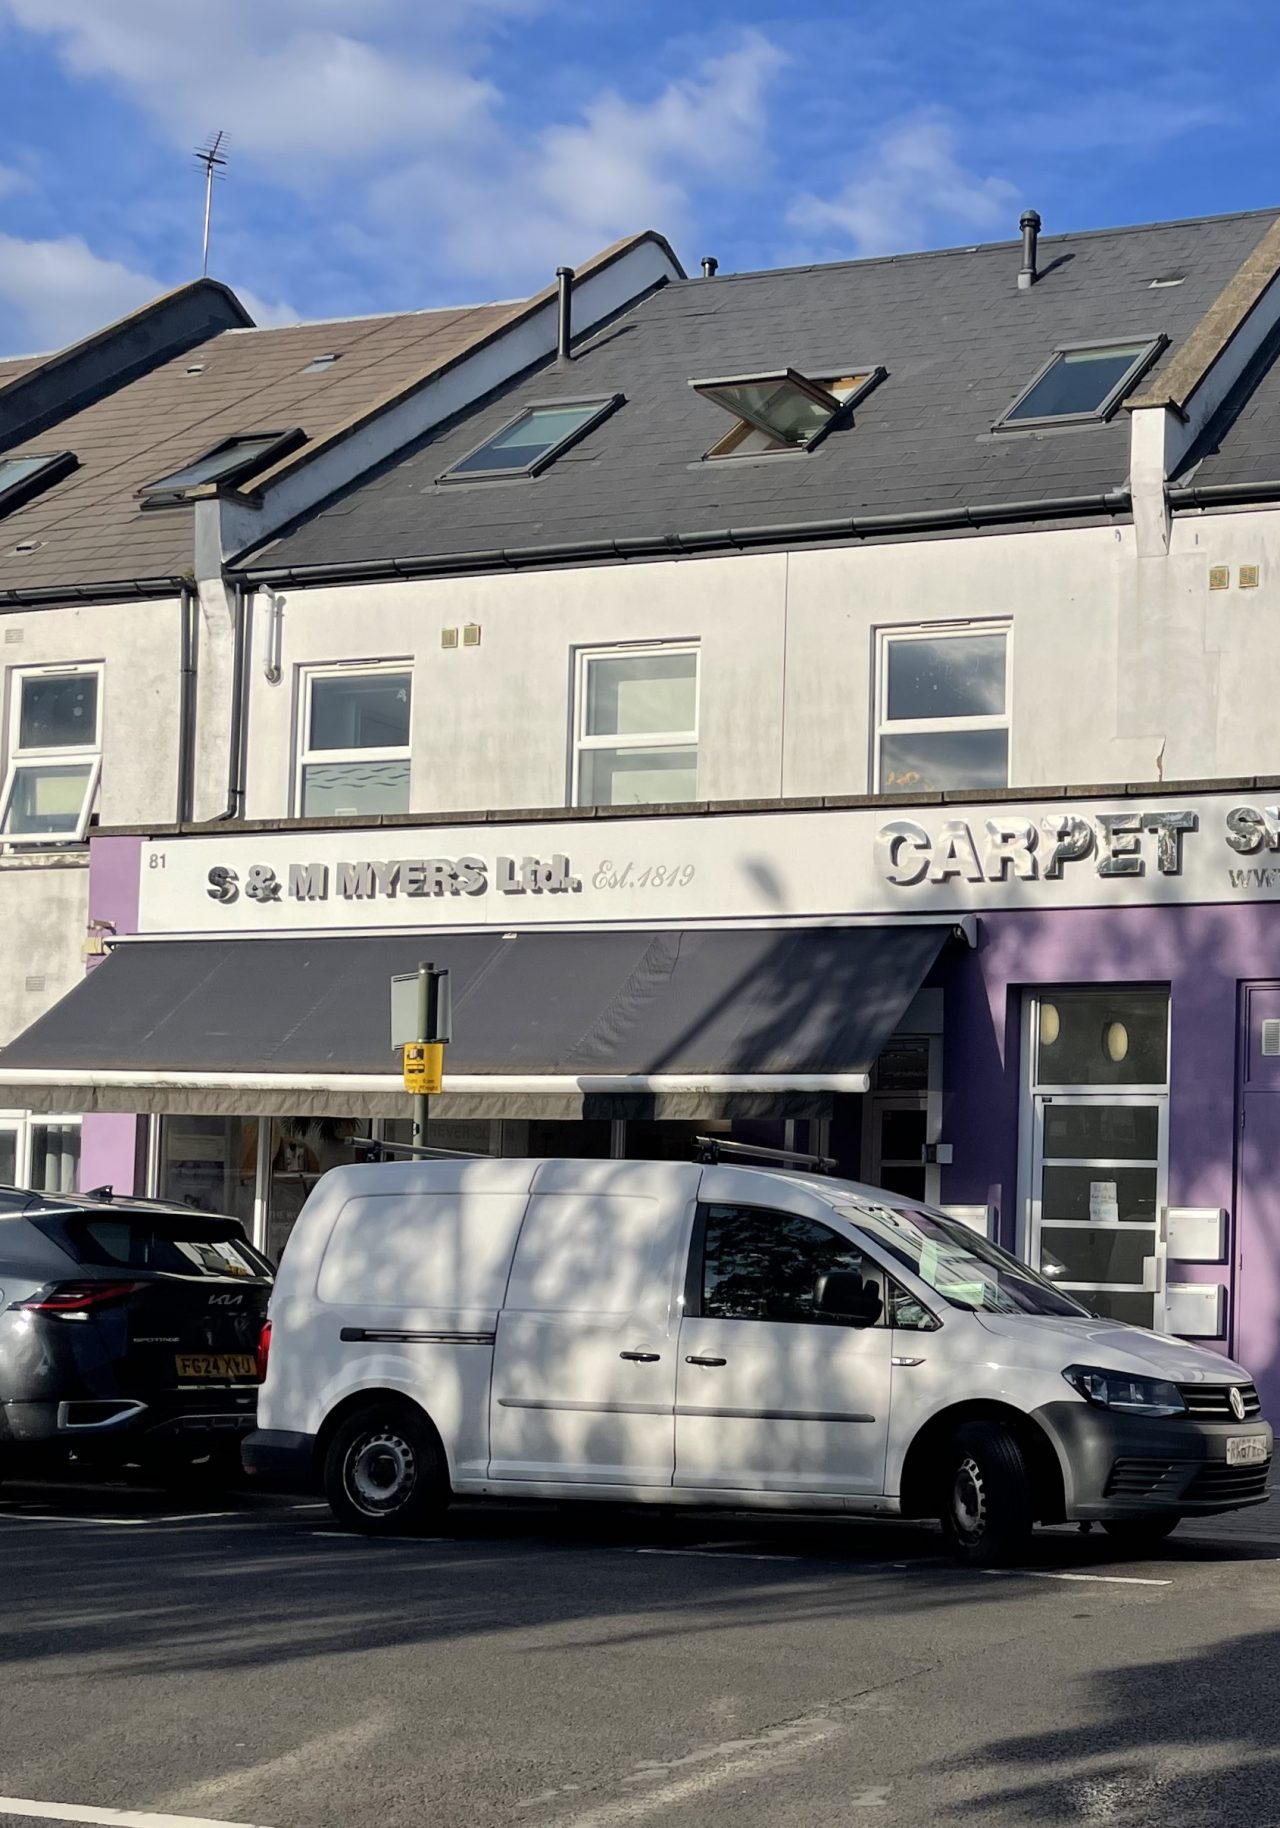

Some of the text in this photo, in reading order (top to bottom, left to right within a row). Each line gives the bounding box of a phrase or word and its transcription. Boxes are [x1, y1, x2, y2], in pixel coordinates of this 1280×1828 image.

[148, 853, 167, 870] 81
[876, 810, 1200, 888] CARPET
[206, 866, 240, 905] S
[245, 864, 284, 903] &
[288, 862, 329, 901] M
[336, 855, 488, 900] MYERS
[496, 853, 583, 896] Ltd.
[181, 1357, 219, 1374] FG24
